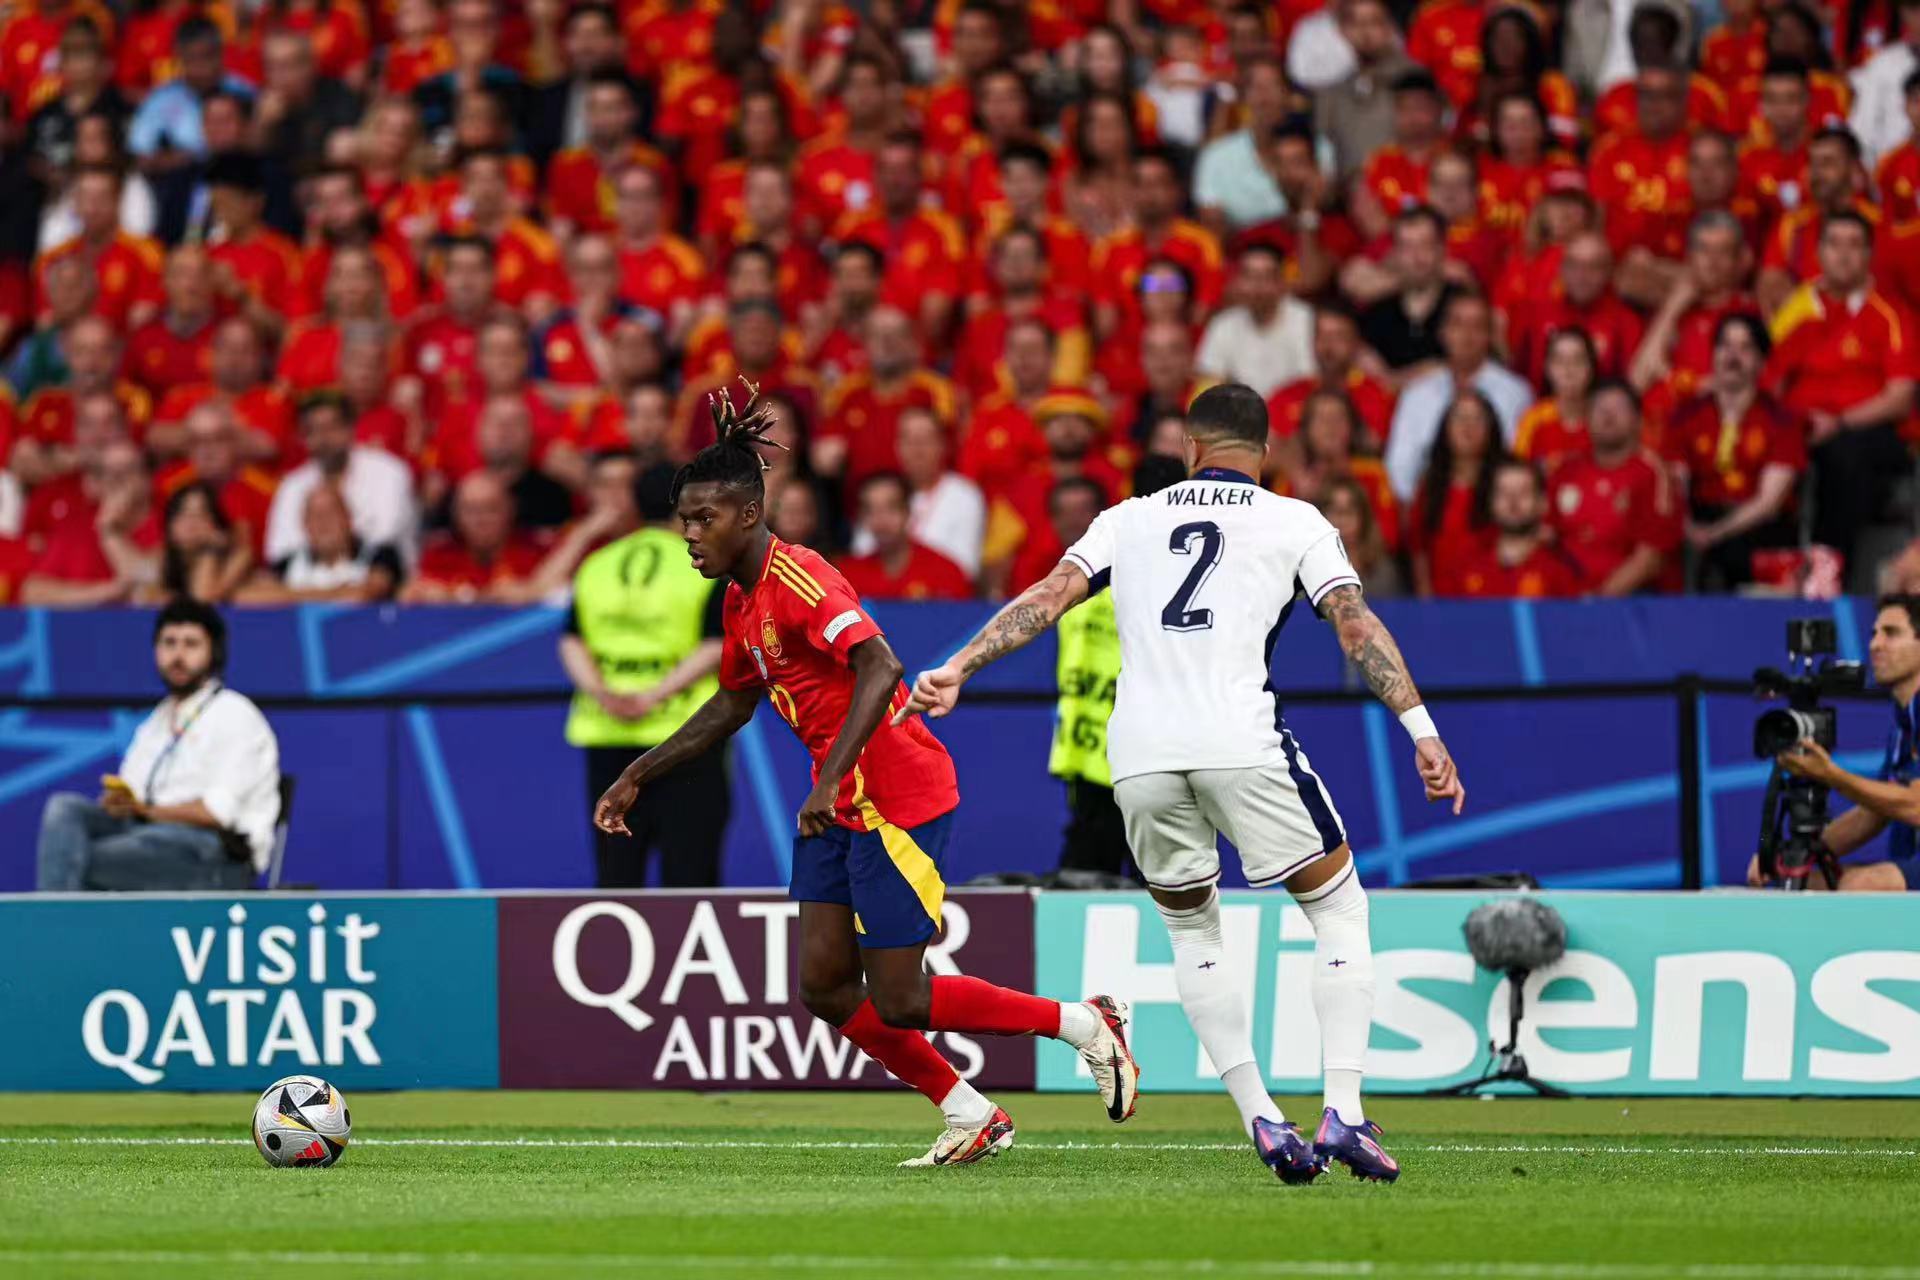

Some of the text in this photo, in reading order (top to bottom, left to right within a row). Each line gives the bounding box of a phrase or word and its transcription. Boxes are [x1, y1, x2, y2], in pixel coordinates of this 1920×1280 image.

[1167, 487, 1254, 506] WALKER
[1161, 520, 1225, 633] 2
[171, 902, 381, 985] visit
[82, 988, 382, 1085] QATAR
